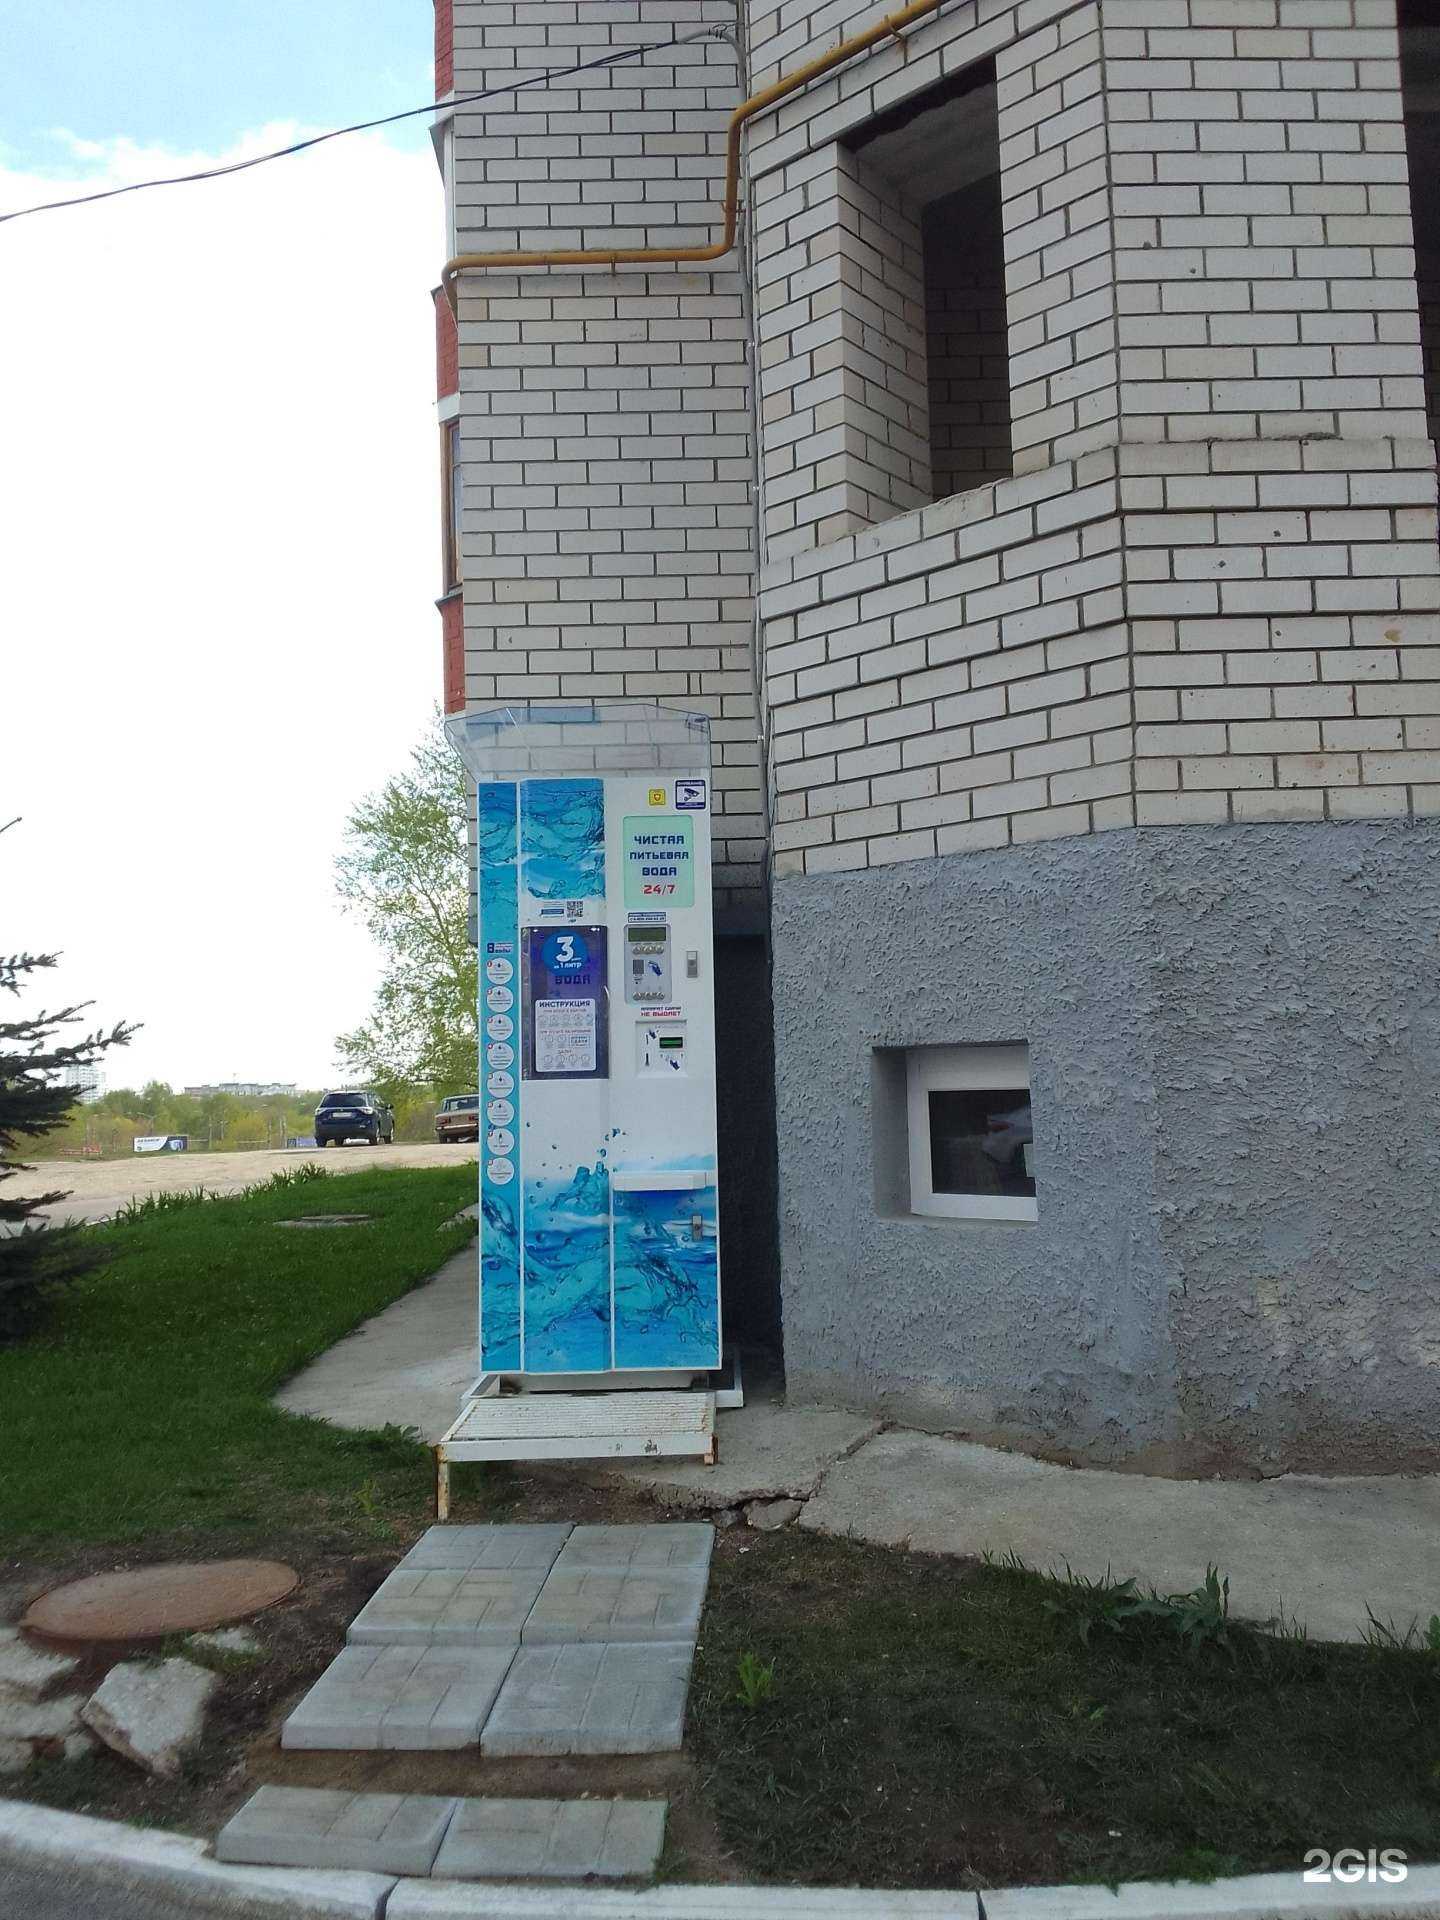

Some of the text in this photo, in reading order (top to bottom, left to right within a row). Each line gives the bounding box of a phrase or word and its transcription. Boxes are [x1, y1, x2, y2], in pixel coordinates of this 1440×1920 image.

[634, 835, 685, 845] ЧИСТАЯ
[630, 851, 689, 860] ПИТЬЕВАЯ
[642, 867, 677, 876] ВОДА
[643, 884, 675, 895] 24/7
[556, 936, 574, 962] 3
[555, 975, 591, 985] ВОДА
[539, 1000, 591, 1008] ИНСТРУКЦИЯ
